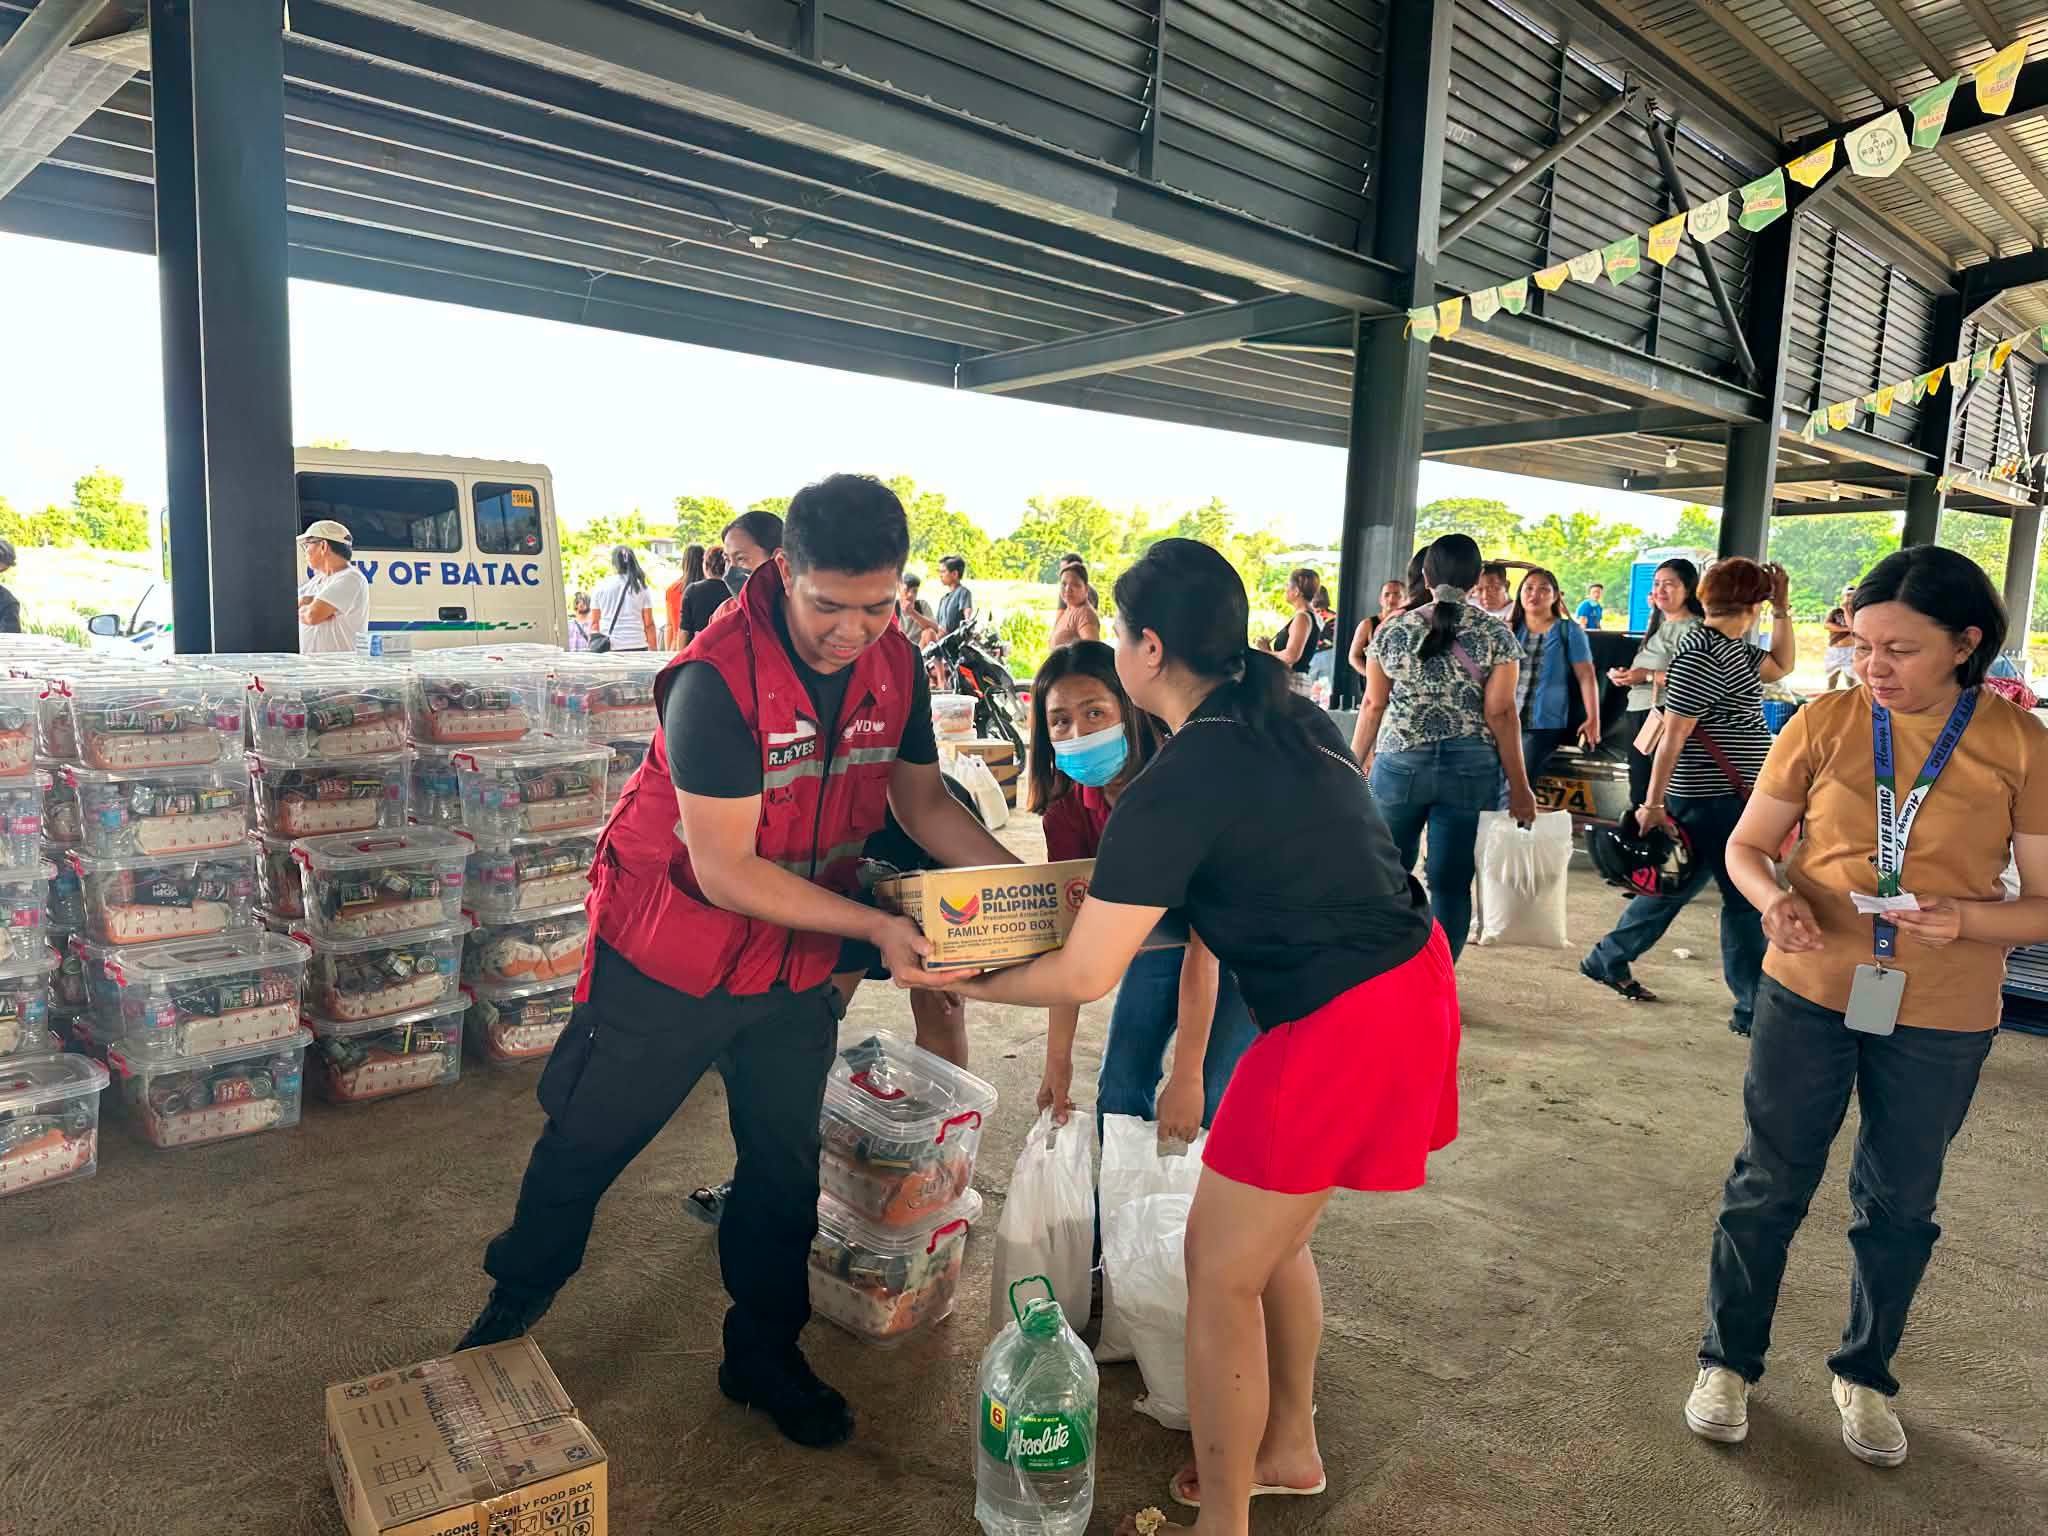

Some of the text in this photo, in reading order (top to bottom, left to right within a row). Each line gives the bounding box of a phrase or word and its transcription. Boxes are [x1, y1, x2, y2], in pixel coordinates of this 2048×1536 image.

[388, 561, 431, 585] OF
[441, 562, 540, 586] BATAC
[1898, 792, 1919, 834] Always
[1879, 789, 1893, 873] CITY OF BATAC
[981, 882, 1057, 901] BAGONG
[982, 898, 1058, 914] PILIPINAS
[947, 920, 1055, 938] FAMILY FOOD BOX
[992, 1407, 1003, 1425] 6
[1004, 1423, 1069, 1460] Absolute
[533, 1488, 565, 1508] FOOD
[568, 1481, 593, 1498] BOX
